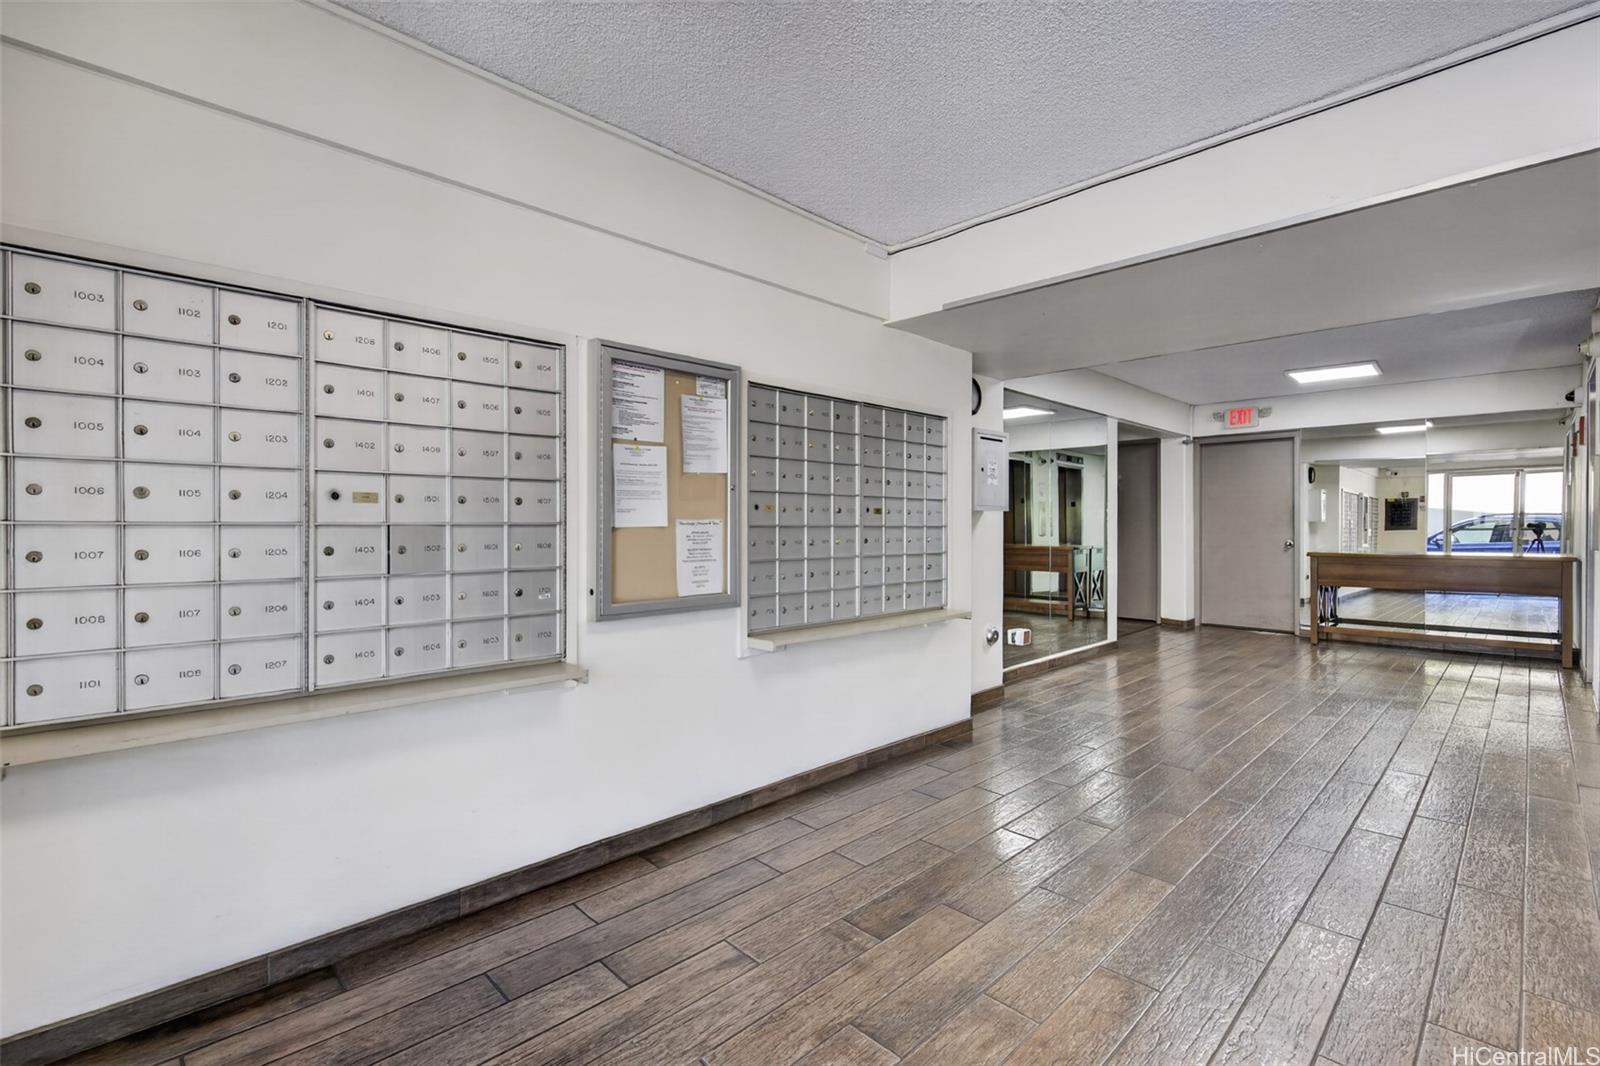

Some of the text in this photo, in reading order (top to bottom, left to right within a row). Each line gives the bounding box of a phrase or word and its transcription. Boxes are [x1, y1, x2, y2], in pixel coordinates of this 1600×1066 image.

[73, 290, 105, 303] 1003
[178, 307, 201, 319] 1102
[267, 321, 288, 331] 1201
[355, 335, 376, 346] 1208
[421, 346, 441, 356] 1406
[73, 355, 105, 367] 1004
[178, 367, 201, 378] 1103
[265, 377, 289, 388] 1202
[356, 389, 375, 398] 1401
[422, 396, 441, 405] 1407
[482, 403, 500, 411] 1506
[1229, 407, 1252, 426] EXIT
[73, 421, 105, 432] 1005
[178, 428, 201, 438] 1104
[265, 434, 289, 444] 1203
[355, 441, 376, 450] 1402
[74, 486, 105, 496] 1006
[178, 489, 202, 498] 1105
[265, 490, 288, 500] 1204
[423, 495, 440, 503] 1501
[178, 549, 202, 558] 1106
[264, 548, 289, 557] 1205
[354, 545, 376, 554] 1403
[74, 550, 105, 560] 1007
[354, 597, 376, 607] 1404
[178, 608, 201, 619] 1107
[264, 604, 288, 613] 1206
[74, 614, 106, 625] 1008
[354, 650, 376, 660] 1405
[264, 659, 288, 670] 1207
[179, 669, 202, 679] 1108
[79, 679, 101, 690] 1101
